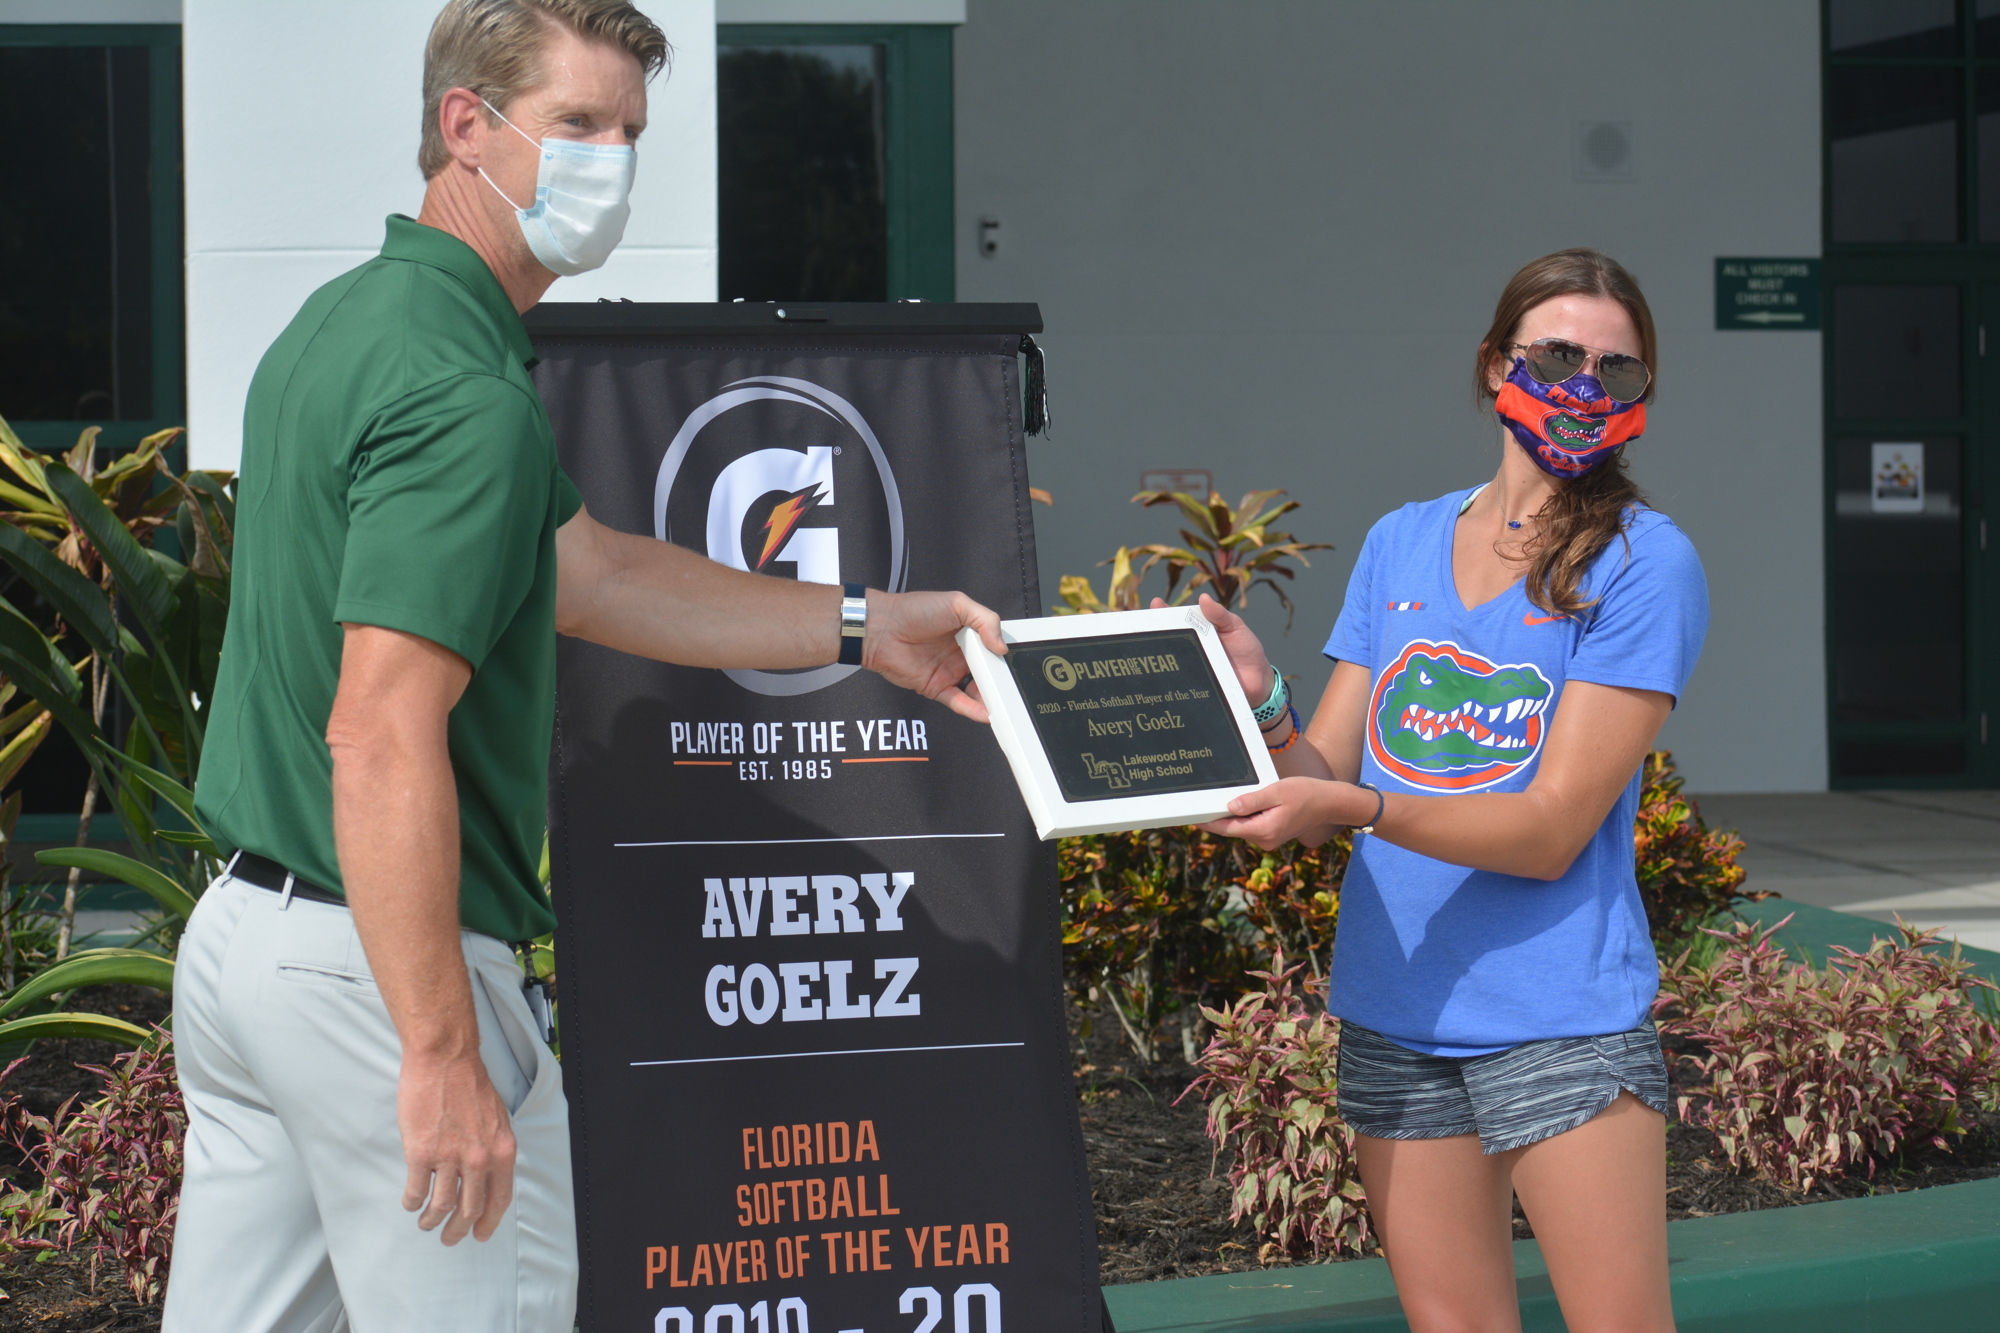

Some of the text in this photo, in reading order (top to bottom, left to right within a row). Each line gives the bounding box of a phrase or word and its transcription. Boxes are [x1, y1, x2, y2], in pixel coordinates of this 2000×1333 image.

[1722, 263, 1809, 277] ALL VISITORS
[1746, 278, 1784, 291] MUST
[1735, 291, 1798, 305] CHECK IN
[1545, 384, 1613, 415] FLORIDA
[1073, 661, 1131, 680] PLAYER
[1128, 658, 1139, 669] OF
[1131, 667, 1143, 675] THE
[1138, 655, 1180, 673] YEAR
[1037, 703, 1061, 714] 2020
[1067, 700, 1100, 711] Florida
[1100, 695, 1135, 707] Softball
[1134, 693, 1162, 706] Player
[1164, 691, 1175, 702] of
[1174, 689, 1189, 701] the
[1189, 688, 1210, 699] Year
[1087, 710, 1185, 738] Avery Goelz
[670, 719, 928, 754] PLAYER OF THE YEAR
[1123, 746, 1213, 766] Lakewood Ranch
[739, 759, 832, 781] EST. 1985
[1128, 762, 1193, 781] High School
[702, 872, 915, 938] AVERY
[704, 957, 921, 1027] GOELZ
[742, 1119, 880, 1171] FLORIDA
[736, 1174, 900, 1227] SOFTBALL
[645, 1222, 1010, 1289] PLAYER OF THE YEAR
